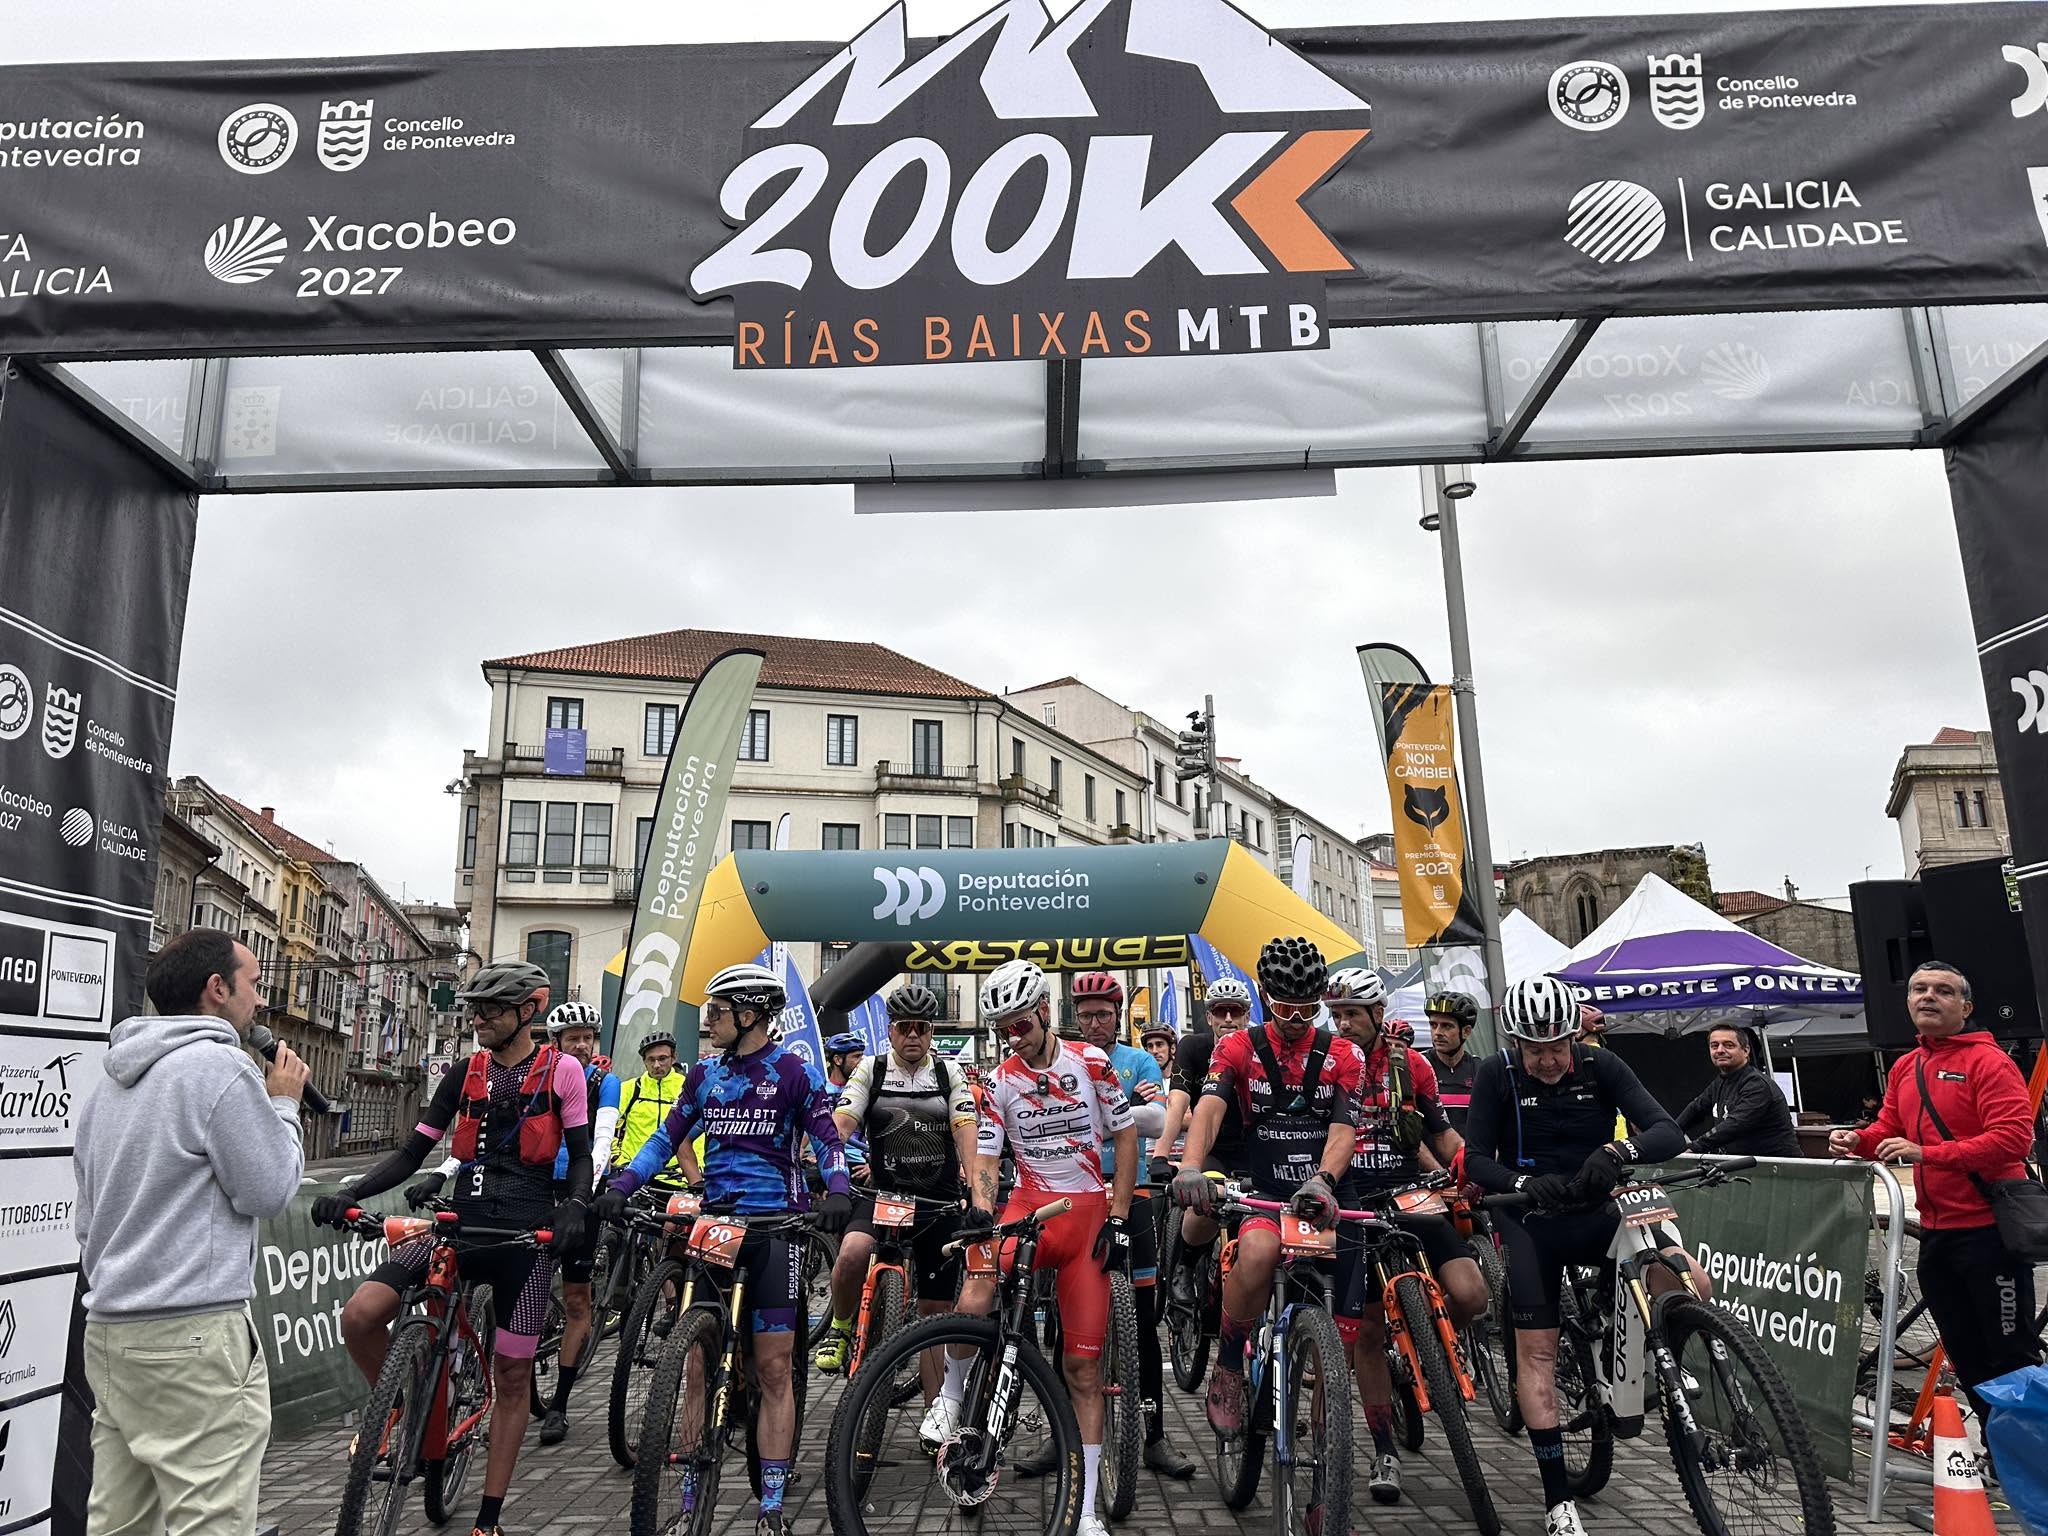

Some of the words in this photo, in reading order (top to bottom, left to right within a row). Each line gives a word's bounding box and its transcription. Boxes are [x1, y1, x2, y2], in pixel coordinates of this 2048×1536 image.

[1716, 76, 1799, 92] Concello
[1558, 96, 1620, 123] PONTEVEDRA
[1719, 94, 1744, 109] de
[1748, 91, 1857, 109] Pontevedra
[384, 116, 464, 133] Concello
[228, 138, 287, 167] PONTEVEDRA
[383, 135, 406, 151] de
[411, 132, 516, 149] Pontevedra
[1705, 180, 1861, 211] GALICIA
[303, 212, 517, 252] Xacobeo
[1709, 220, 1908, 252] CALIDADE
[296, 266, 403, 298] 2027
[738, 311, 879, 366] RÍAS
[925, 309, 1153, 360] BAIXAS
[1177, 303, 1321, 352] MTB
[87, 719, 125, 747] Concello
[84, 736, 97, 752] de
[98, 745, 153, 774] Pontevedra
[1396, 742, 1446, 751] PONTEVEDRA
[1405, 752, 1435, 765] NON
[0, 812, 22, 832] 027
[102, 819, 139, 842] GALICIA
[650, 754, 700, 916] Deputación
[667, 762, 717, 920] Pontevedra
[101, 838, 147, 861] CALIDADE
[958, 867, 1090, 895] Deputación
[958, 890, 1091, 913] Pontevedra
[51, 970, 102, 986] PONTEVEDRA
[1573, 978, 1718, 1002] DEPORTE
[0, 1065, 39, 1079] Pizzería
[0, 1080, 71, 1118] arlos
[1017, 1101, 1088, 1119] ORBEA
[704, 1108, 749, 1119] ESCUELA
[753, 1109, 777, 1120] BTT
[1018, 1114, 1092, 1139] MPC
[1619, 1186, 1667, 1205] 109A
[709, 1226, 732, 1243] 90
[1697, 1242, 1842, 1303] Deputación
[1614, 1269, 1628, 1383] ORBEA
[1064, 1451, 1078, 1527] MAXXIS
